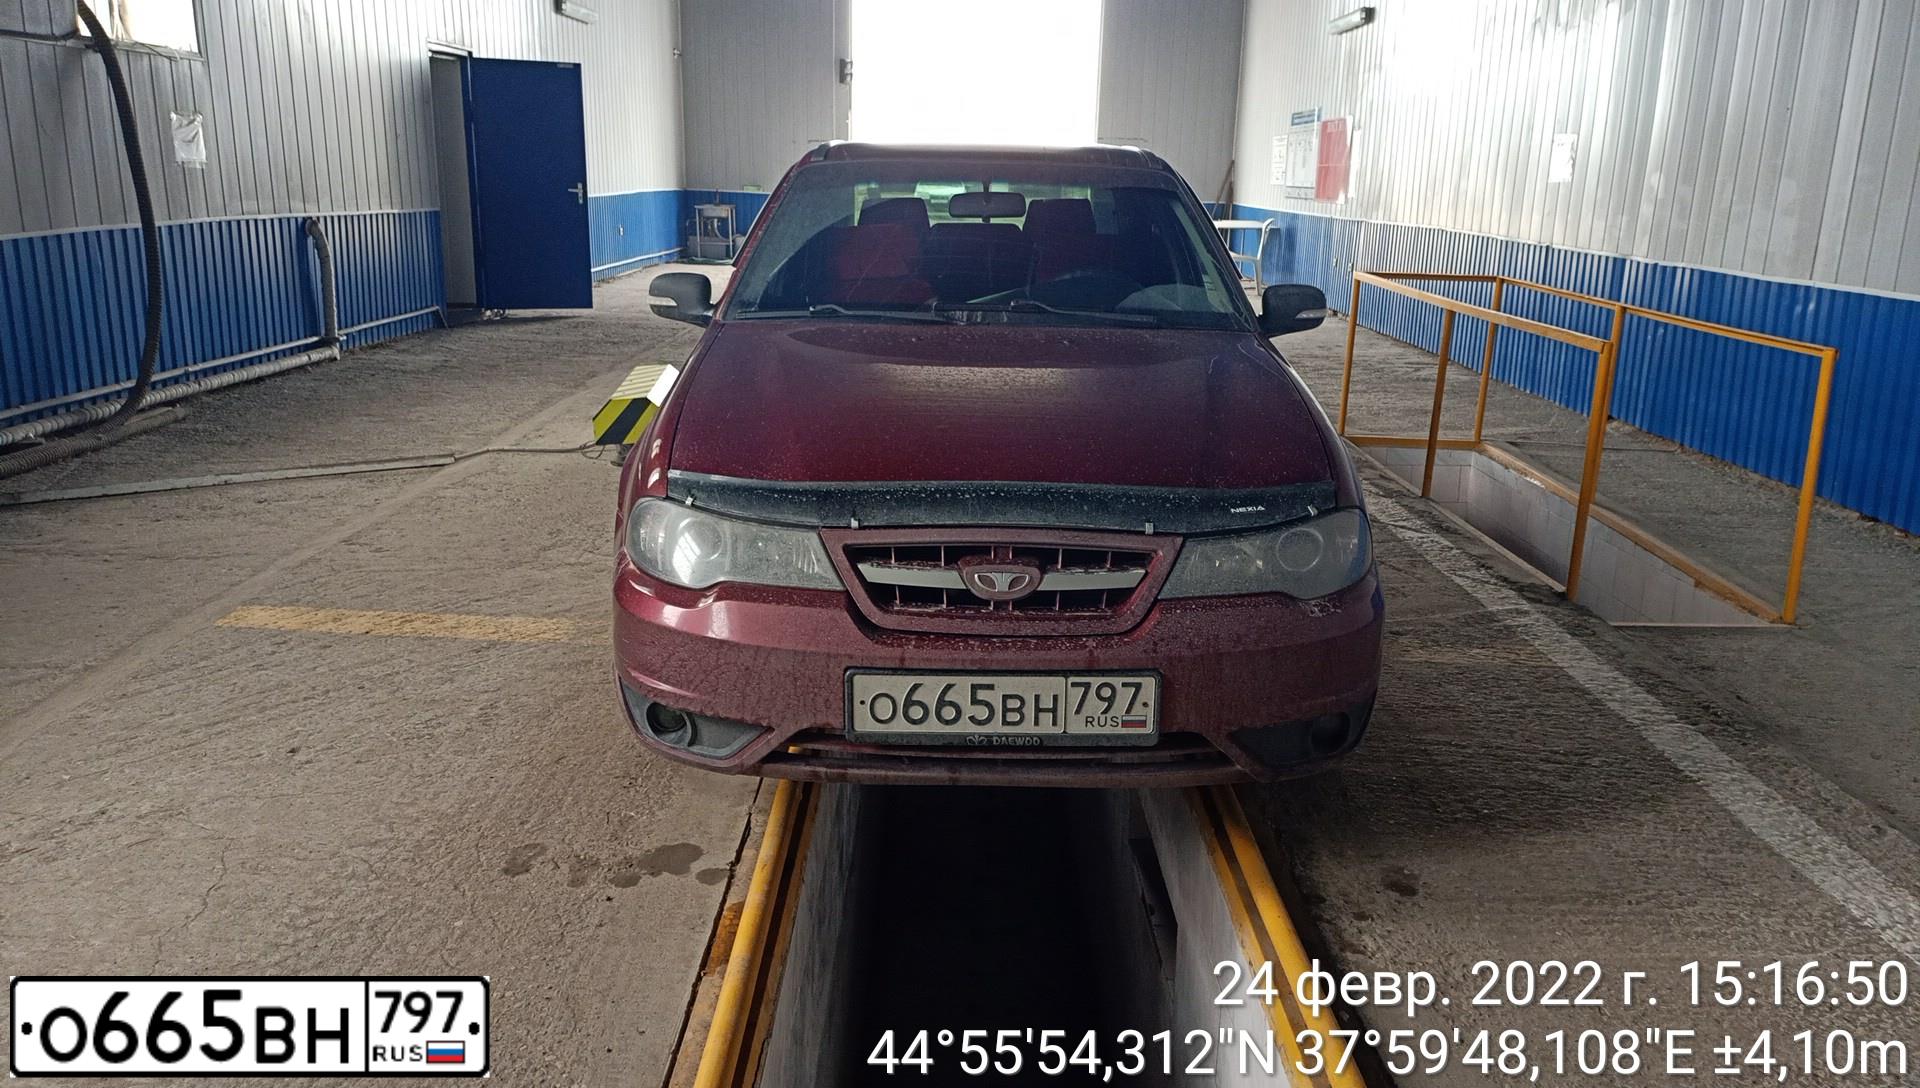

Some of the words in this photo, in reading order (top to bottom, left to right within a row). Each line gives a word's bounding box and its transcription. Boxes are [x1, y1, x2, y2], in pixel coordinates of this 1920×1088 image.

[1230, 505, 1265, 513] NEXIA
[1070, 681, 1143, 715] 797
[1085, 715, 1119, 728] RUS
